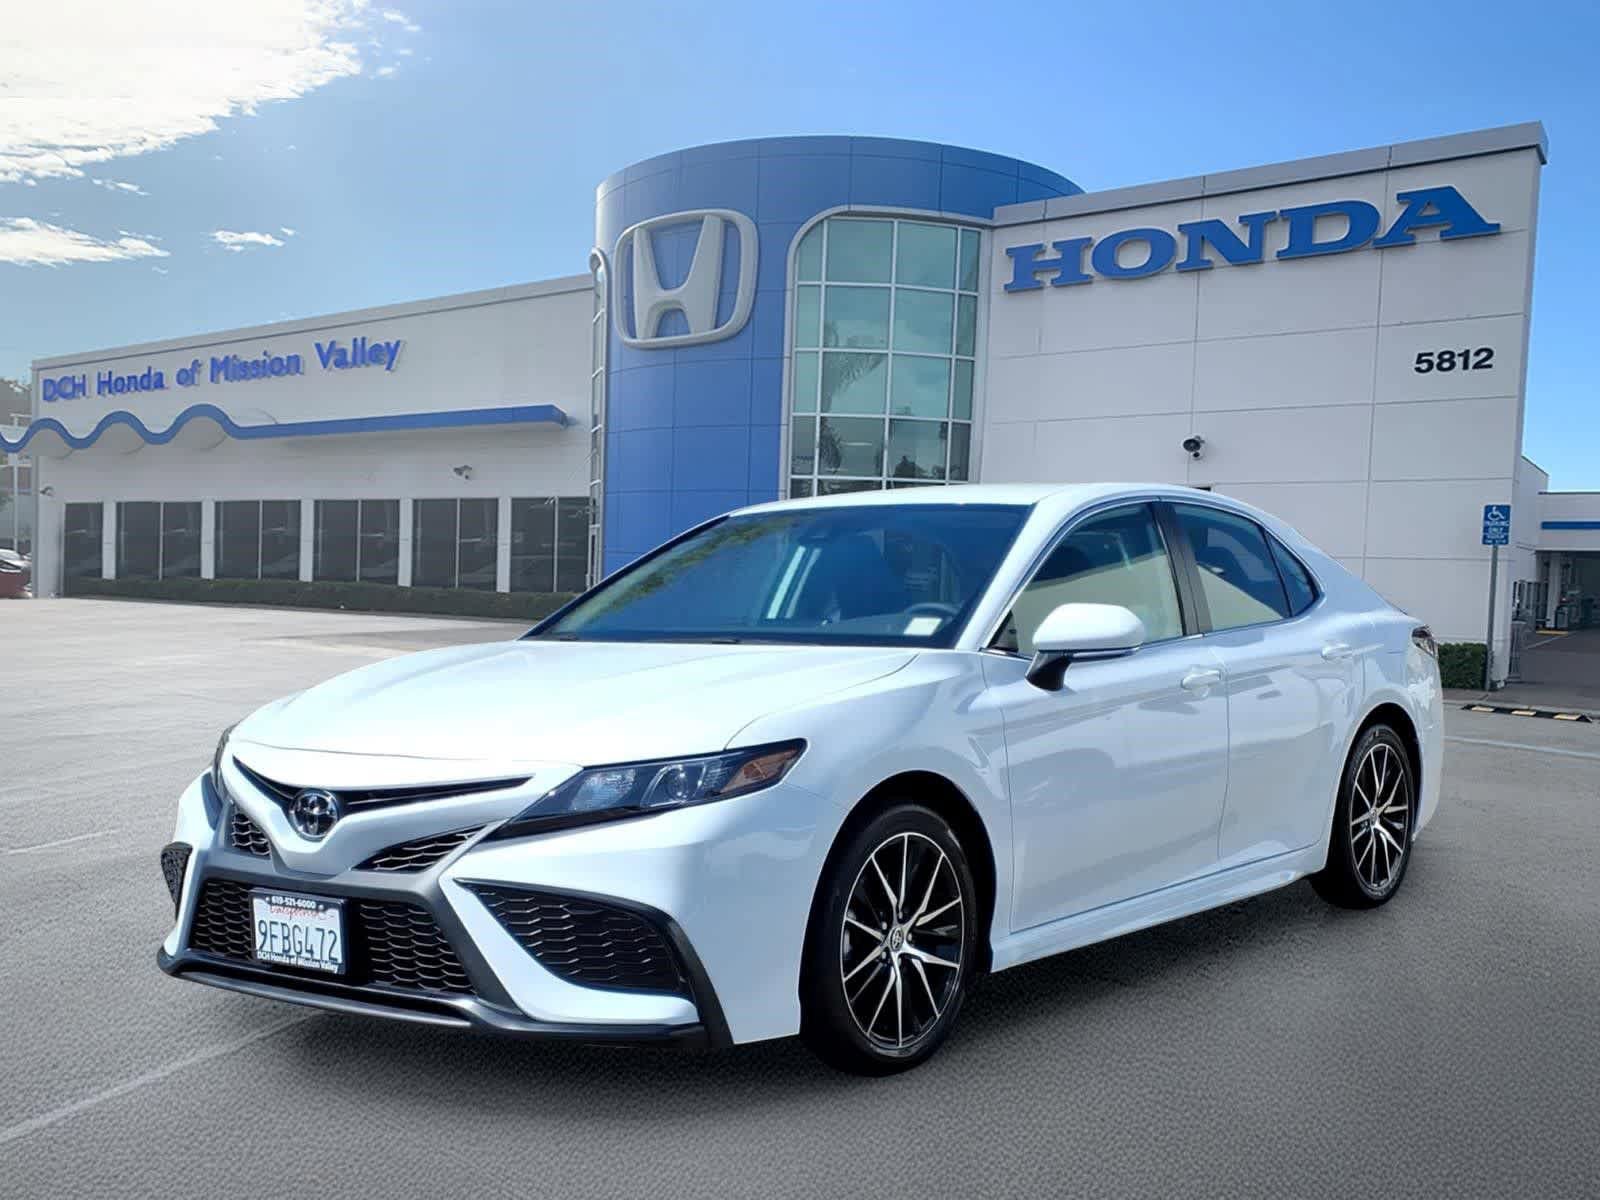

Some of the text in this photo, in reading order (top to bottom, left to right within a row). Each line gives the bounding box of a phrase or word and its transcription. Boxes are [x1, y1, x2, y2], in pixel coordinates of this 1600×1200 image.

[1003, 184, 1502, 293] HONDA
[42, 336, 402, 402] DCH Honda of Mission Valley
[1413, 347, 1495, 374] 5812
[258, 919, 338, 962] 9FBG472
